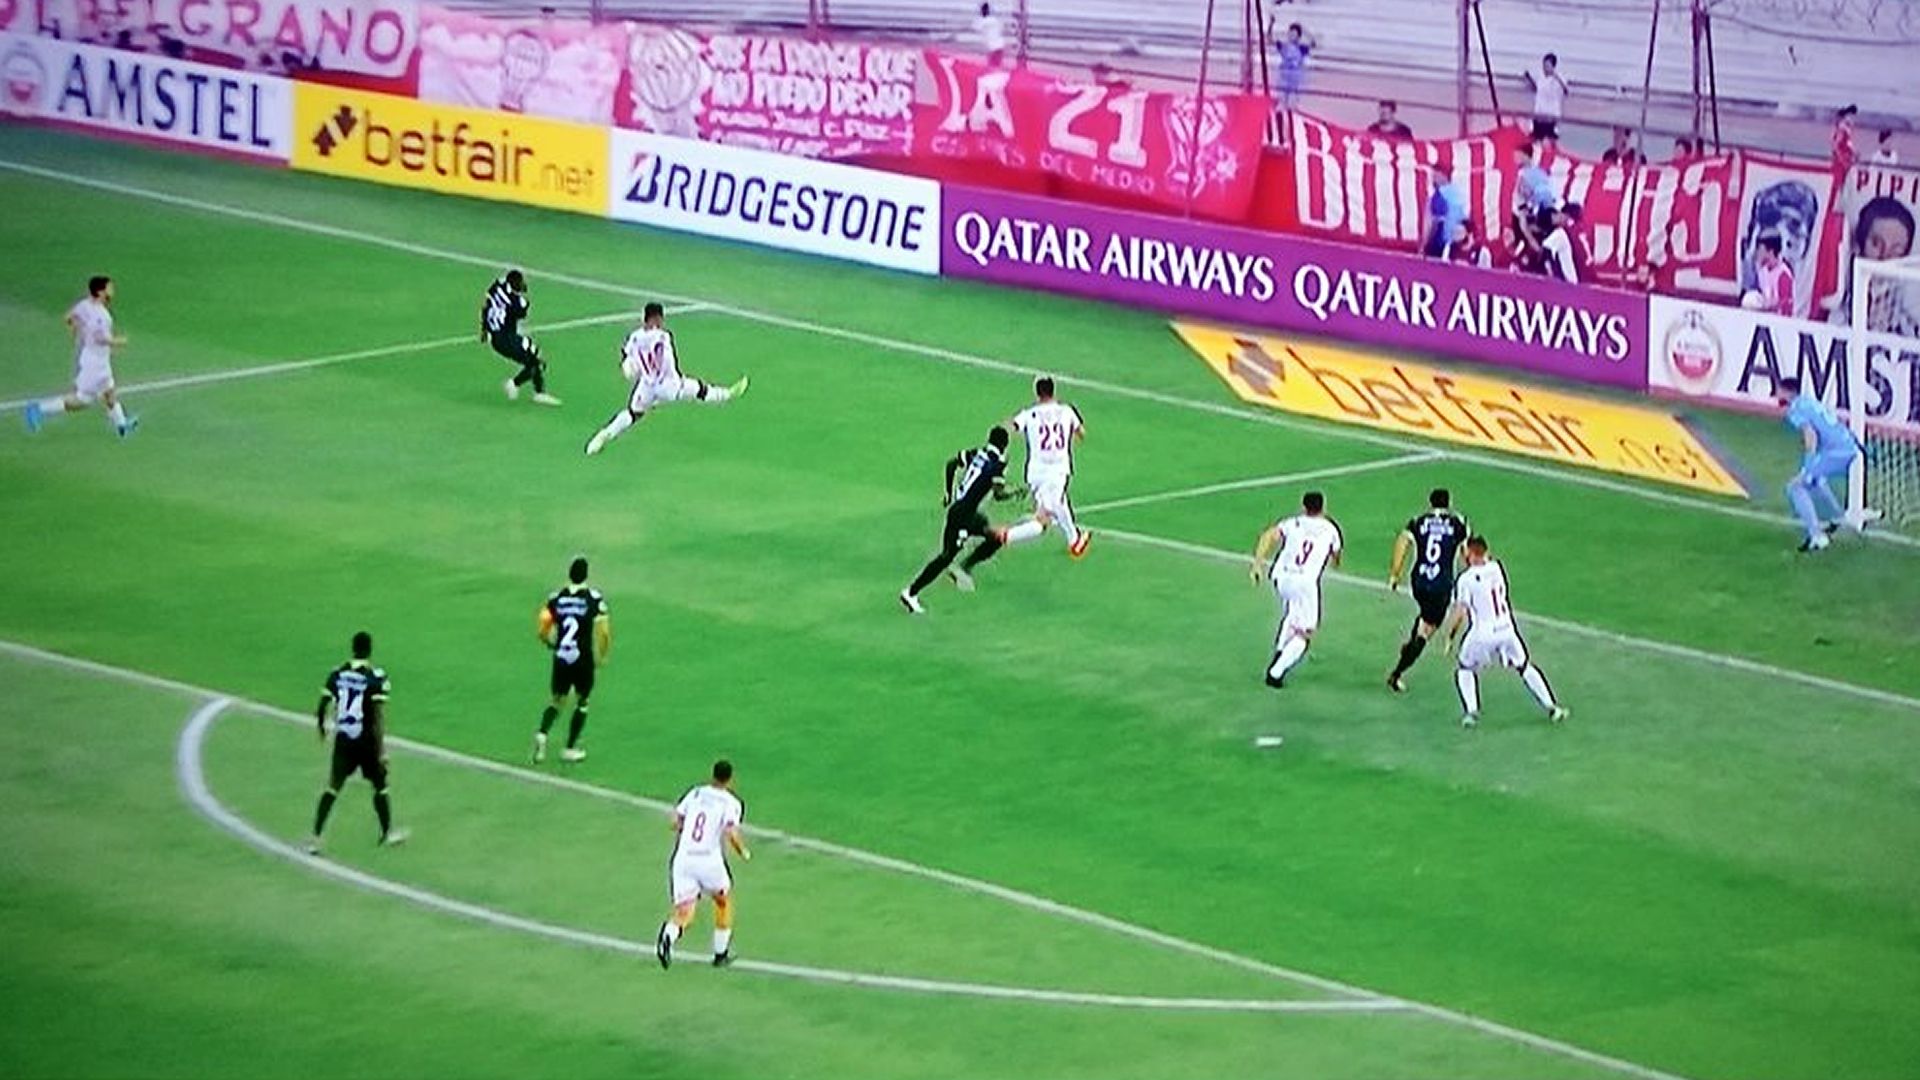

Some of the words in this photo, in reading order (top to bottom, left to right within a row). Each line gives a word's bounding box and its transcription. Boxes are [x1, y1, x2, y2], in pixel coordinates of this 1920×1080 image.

[57, 54, 271, 147] AMSTEL
[938, 56, 1015, 138] LA
[1045, 77, 1149, 168] 21
[626, 153, 925, 250] BRIDGESTONE
[1293, 111, 1728, 268] BARRCAS
[954, 212, 1092, 273] QATAR
[1101, 233, 1275, 301] AIRWAYS
[1294, 264, 1436, 329] QATAR
[1448, 288, 1630, 361] AIRWAYS
[1039, 423, 1066, 450] 23
[1294, 539, 1314, 566] 9
[1425, 533, 1443, 564] 6
[560, 616, 580, 648] 2
[691, 811, 707, 843] 8
